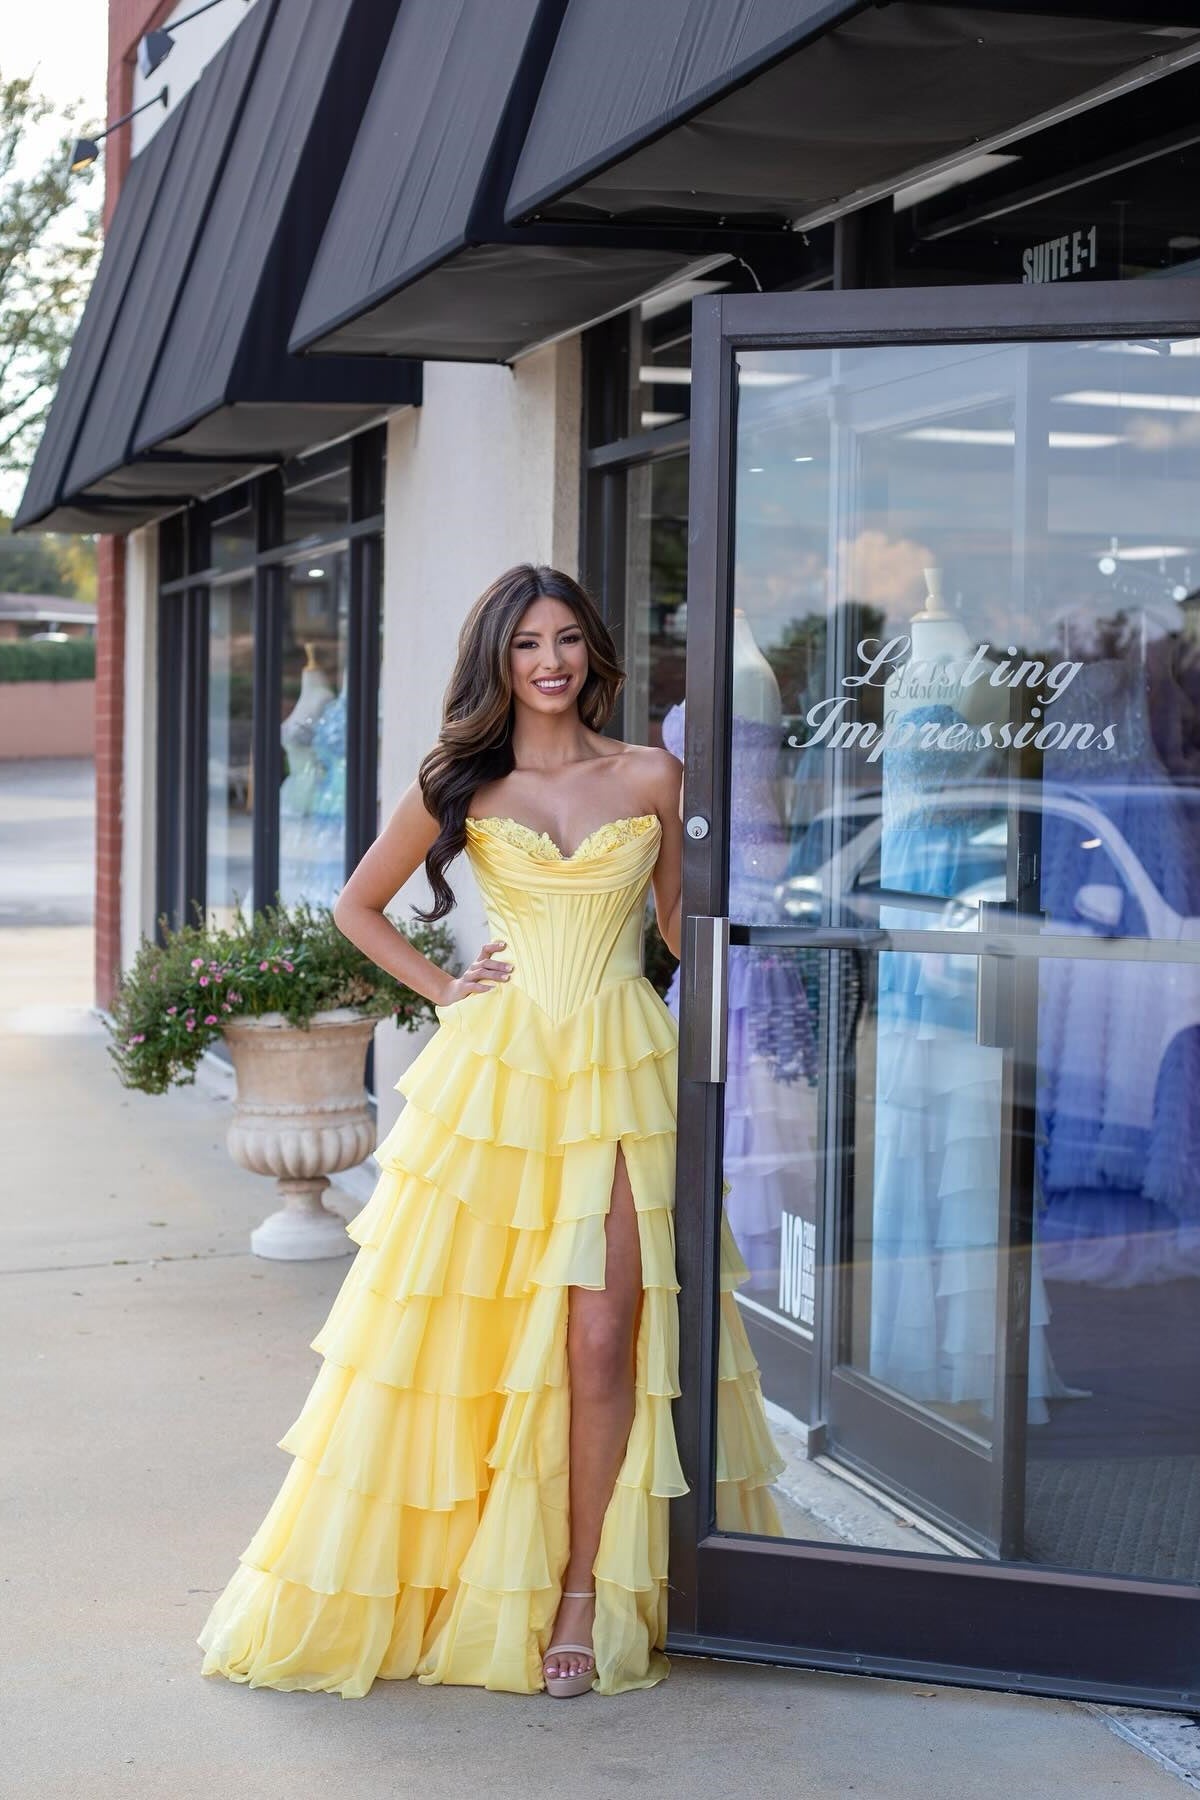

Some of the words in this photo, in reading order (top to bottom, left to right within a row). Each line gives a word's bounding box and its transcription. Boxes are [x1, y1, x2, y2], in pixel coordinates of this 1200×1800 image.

[1022, 235, 1069, 284] SUITE
[1072, 225, 1096, 274] E-1
[841, 635, 1084, 704] Lasting
[788, 696, 1117, 763] Impressions
[779, 1210, 803, 1318] NO
